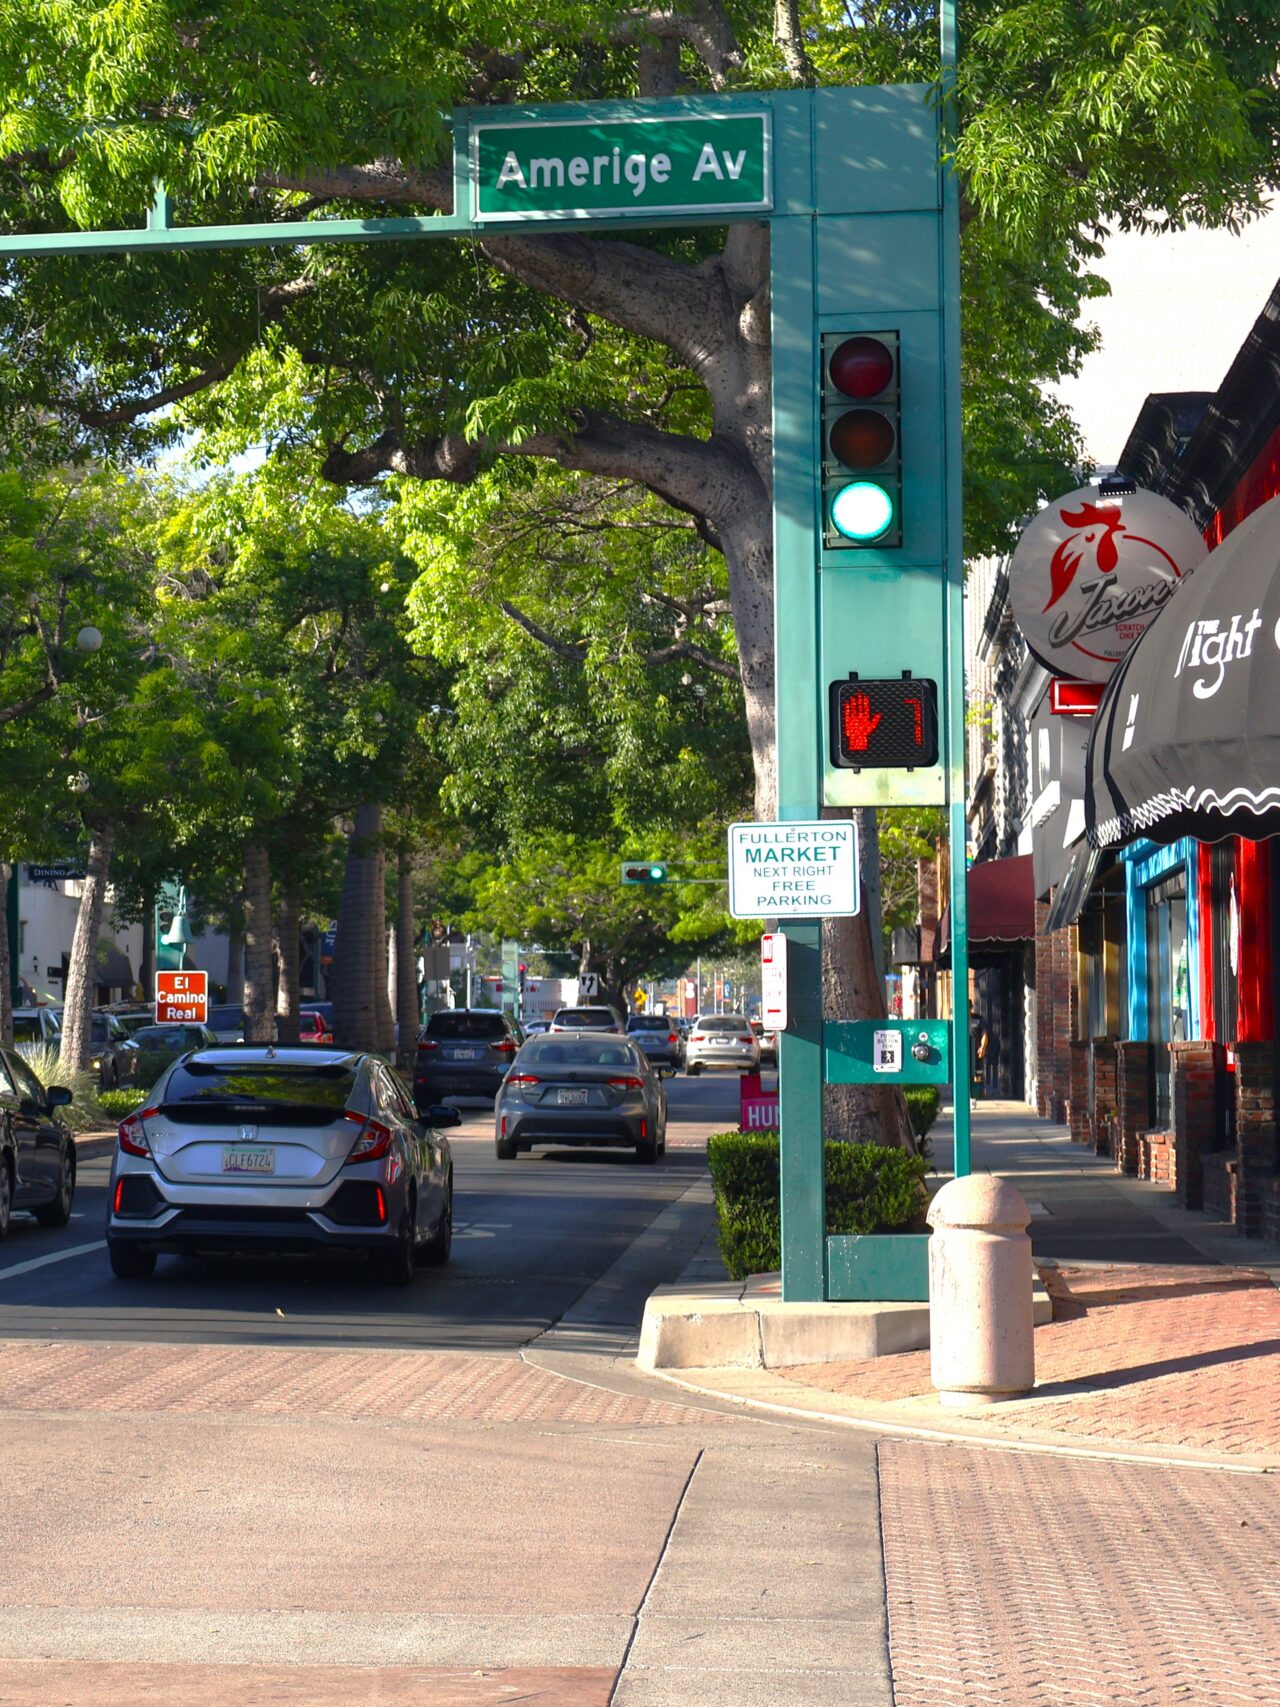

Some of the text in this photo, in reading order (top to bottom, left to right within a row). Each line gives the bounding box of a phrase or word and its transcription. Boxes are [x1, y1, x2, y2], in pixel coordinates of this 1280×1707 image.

[496, 143, 747, 197] Amerige Av
[739, 831, 847, 844] FULLERTON
[745, 846, 841, 863] MARKET
[753, 865, 834, 877] NEXT RIGHT
[773, 881, 816, 891] FREE
[757, 894, 832, 906] PARKING
[174, 976, 189, 989] El
[158, 990, 206, 1003] Camino
[167, 1007, 196, 1019] Real
[228, 1152, 272, 1168] CLF6724
